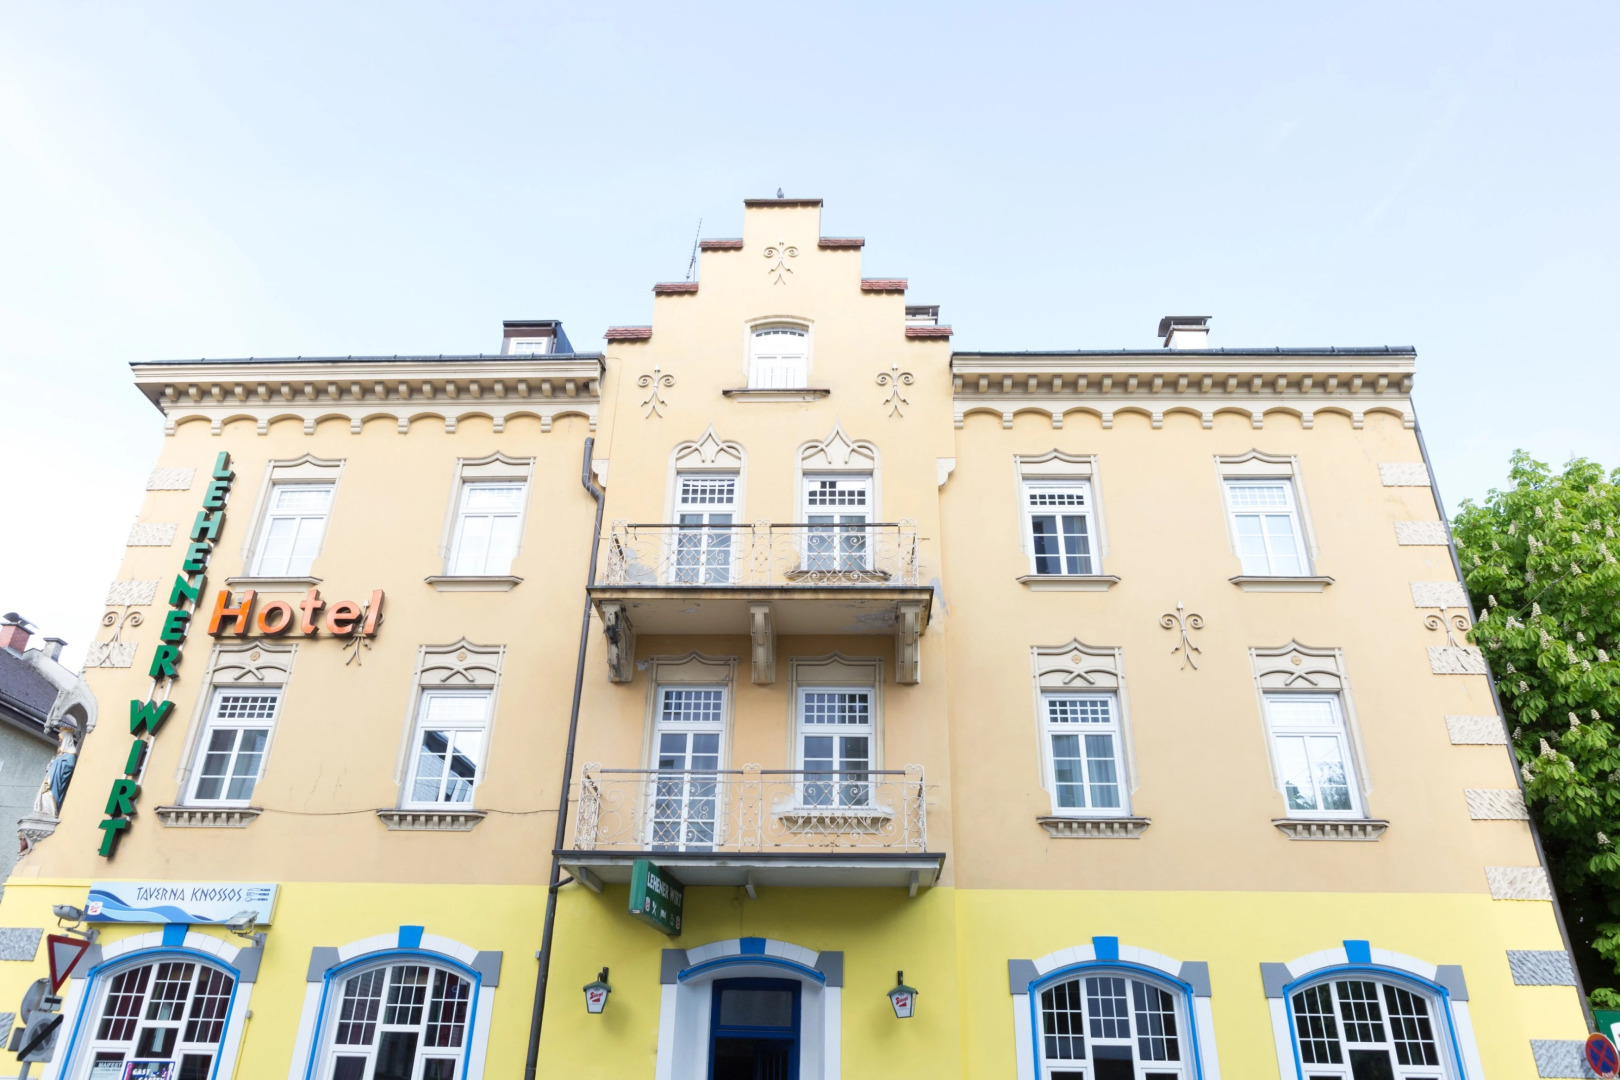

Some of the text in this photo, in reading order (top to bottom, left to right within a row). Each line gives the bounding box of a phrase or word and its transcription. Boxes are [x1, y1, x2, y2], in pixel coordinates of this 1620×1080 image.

[207, 588, 386, 638] Hotel
[98, 450, 236, 859] LEHENER WIRT
[136, 886, 243, 902] TAVERNA KNOSSOS
